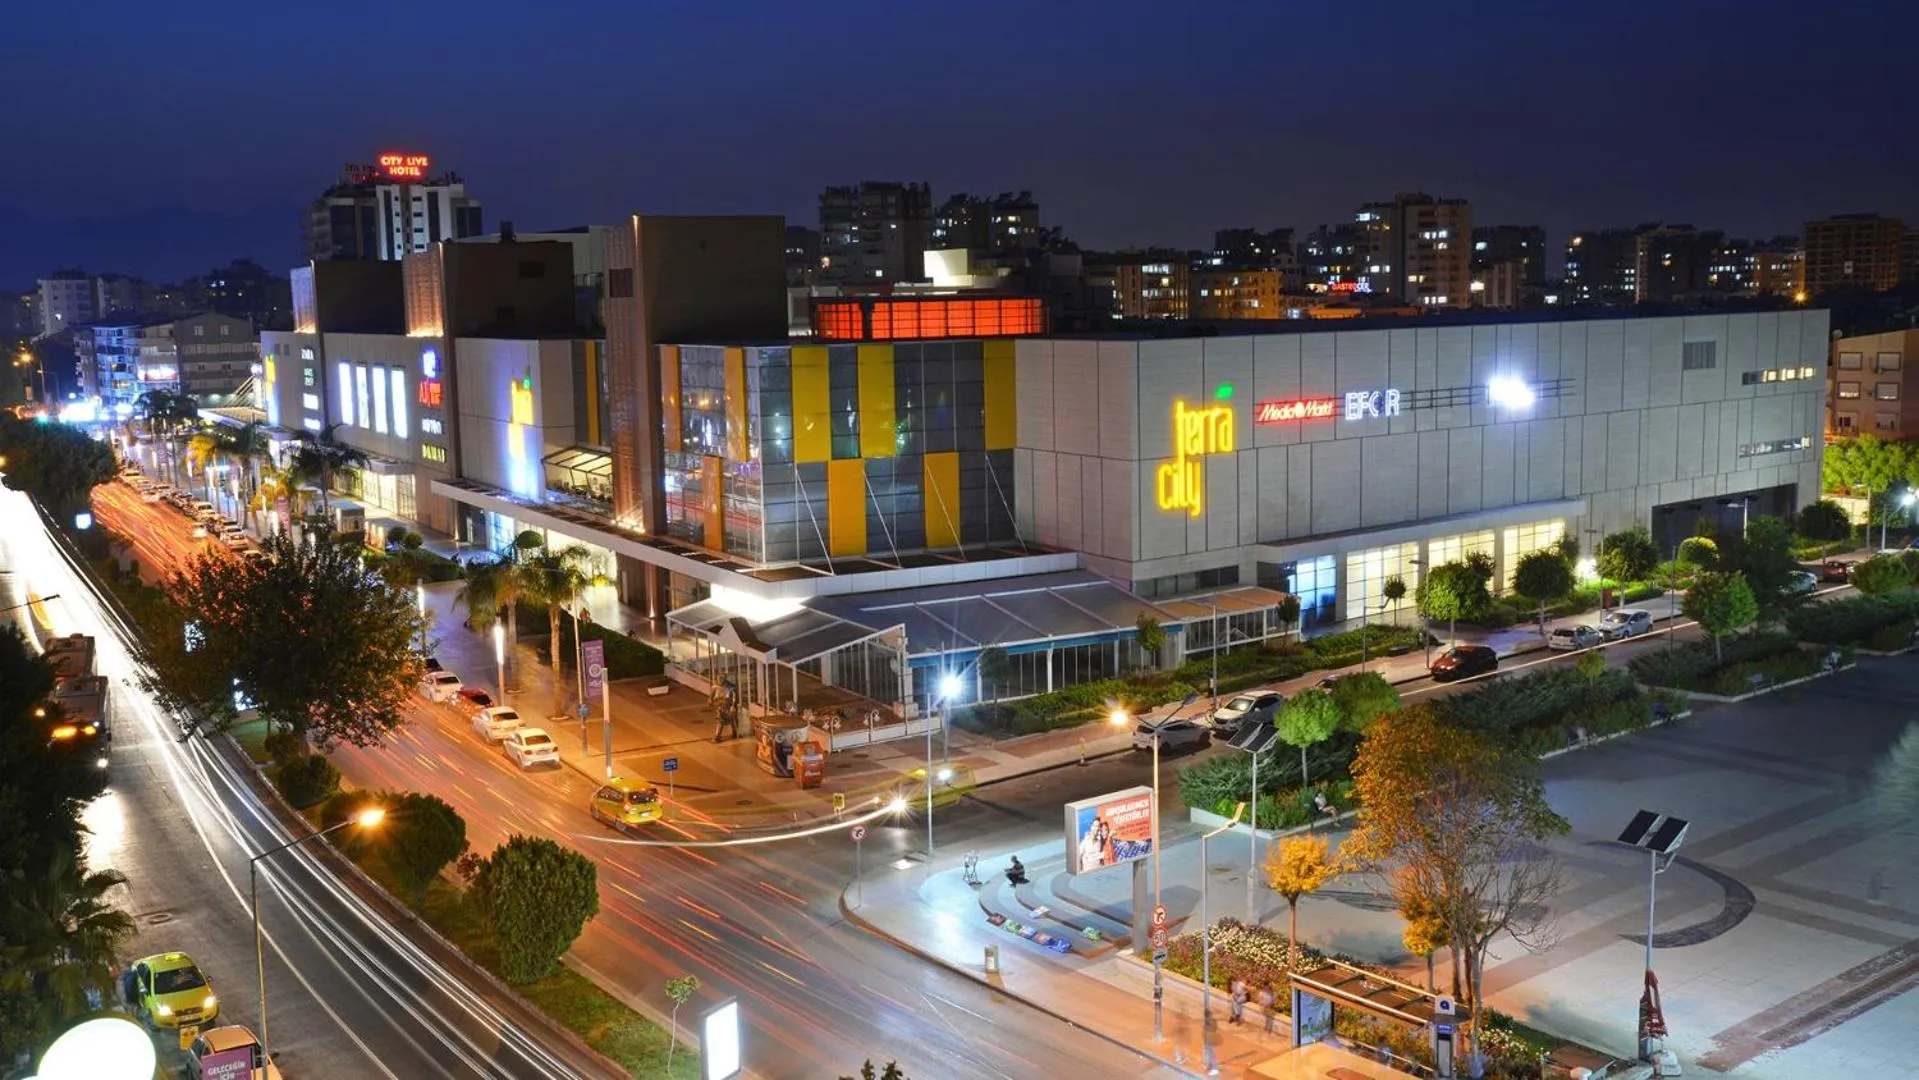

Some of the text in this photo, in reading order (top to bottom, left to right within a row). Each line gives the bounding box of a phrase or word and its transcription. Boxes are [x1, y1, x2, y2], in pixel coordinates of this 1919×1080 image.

[381, 156, 428, 166] CITY LIVE
[390, 167, 420, 176] HOTEL
[1175, 400, 1232, 455] terra
[1158, 460, 1201, 517] city
